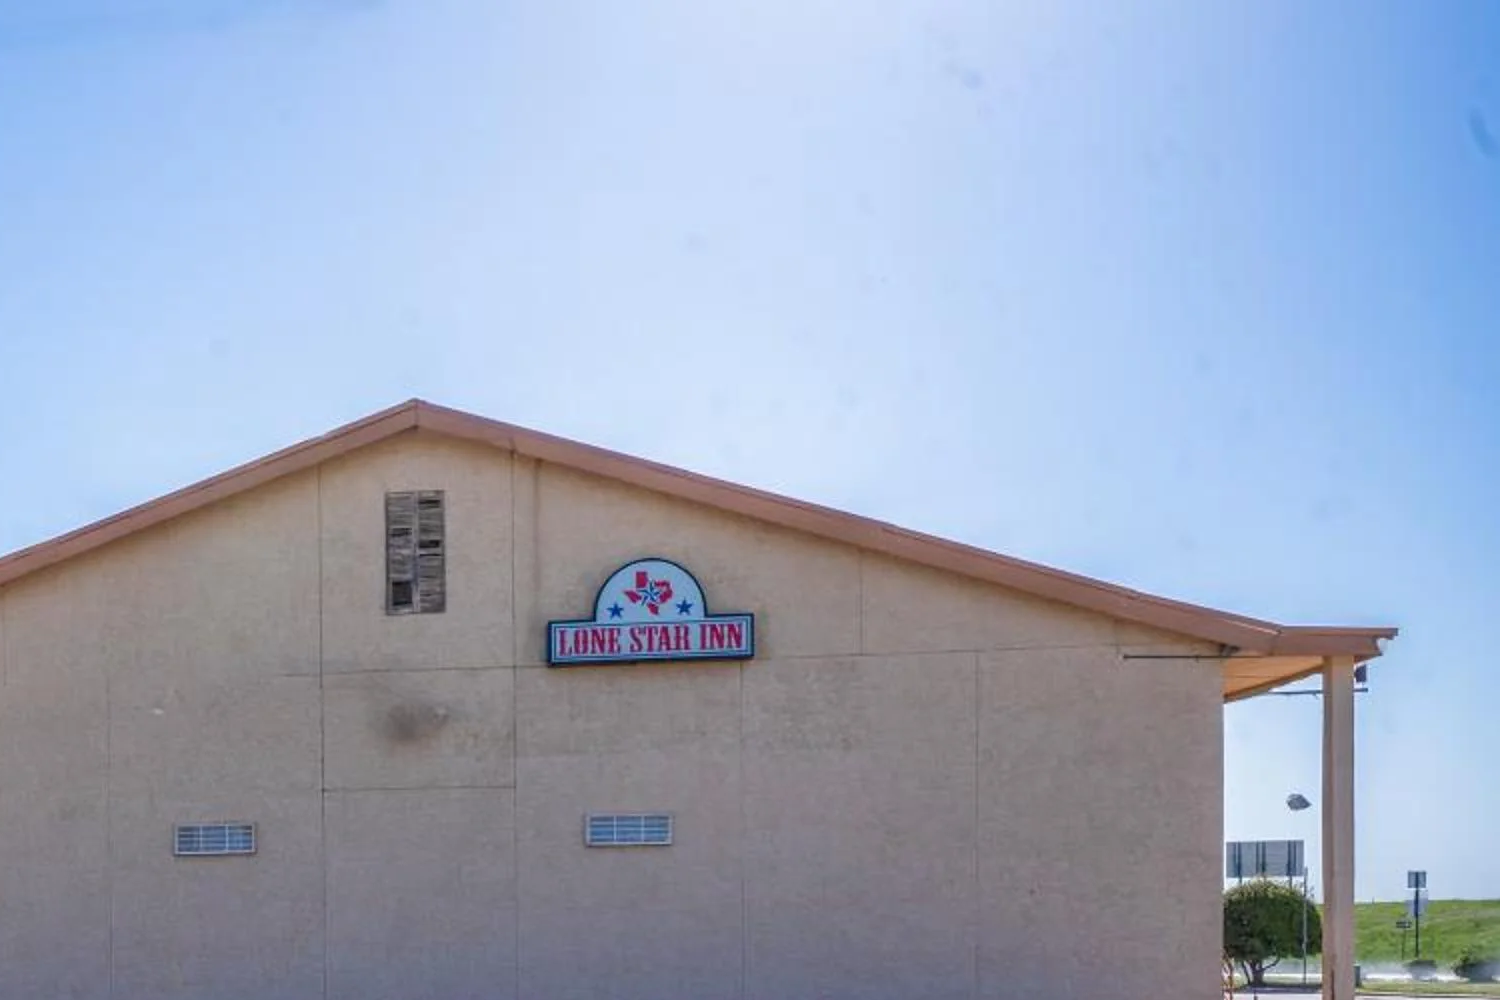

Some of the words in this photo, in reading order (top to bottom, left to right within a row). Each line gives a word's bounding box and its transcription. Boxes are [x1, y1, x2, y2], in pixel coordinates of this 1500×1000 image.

[558, 627, 621, 656] LONE
[629, 624, 690, 653] STAR
[700, 623, 743, 649] INN
